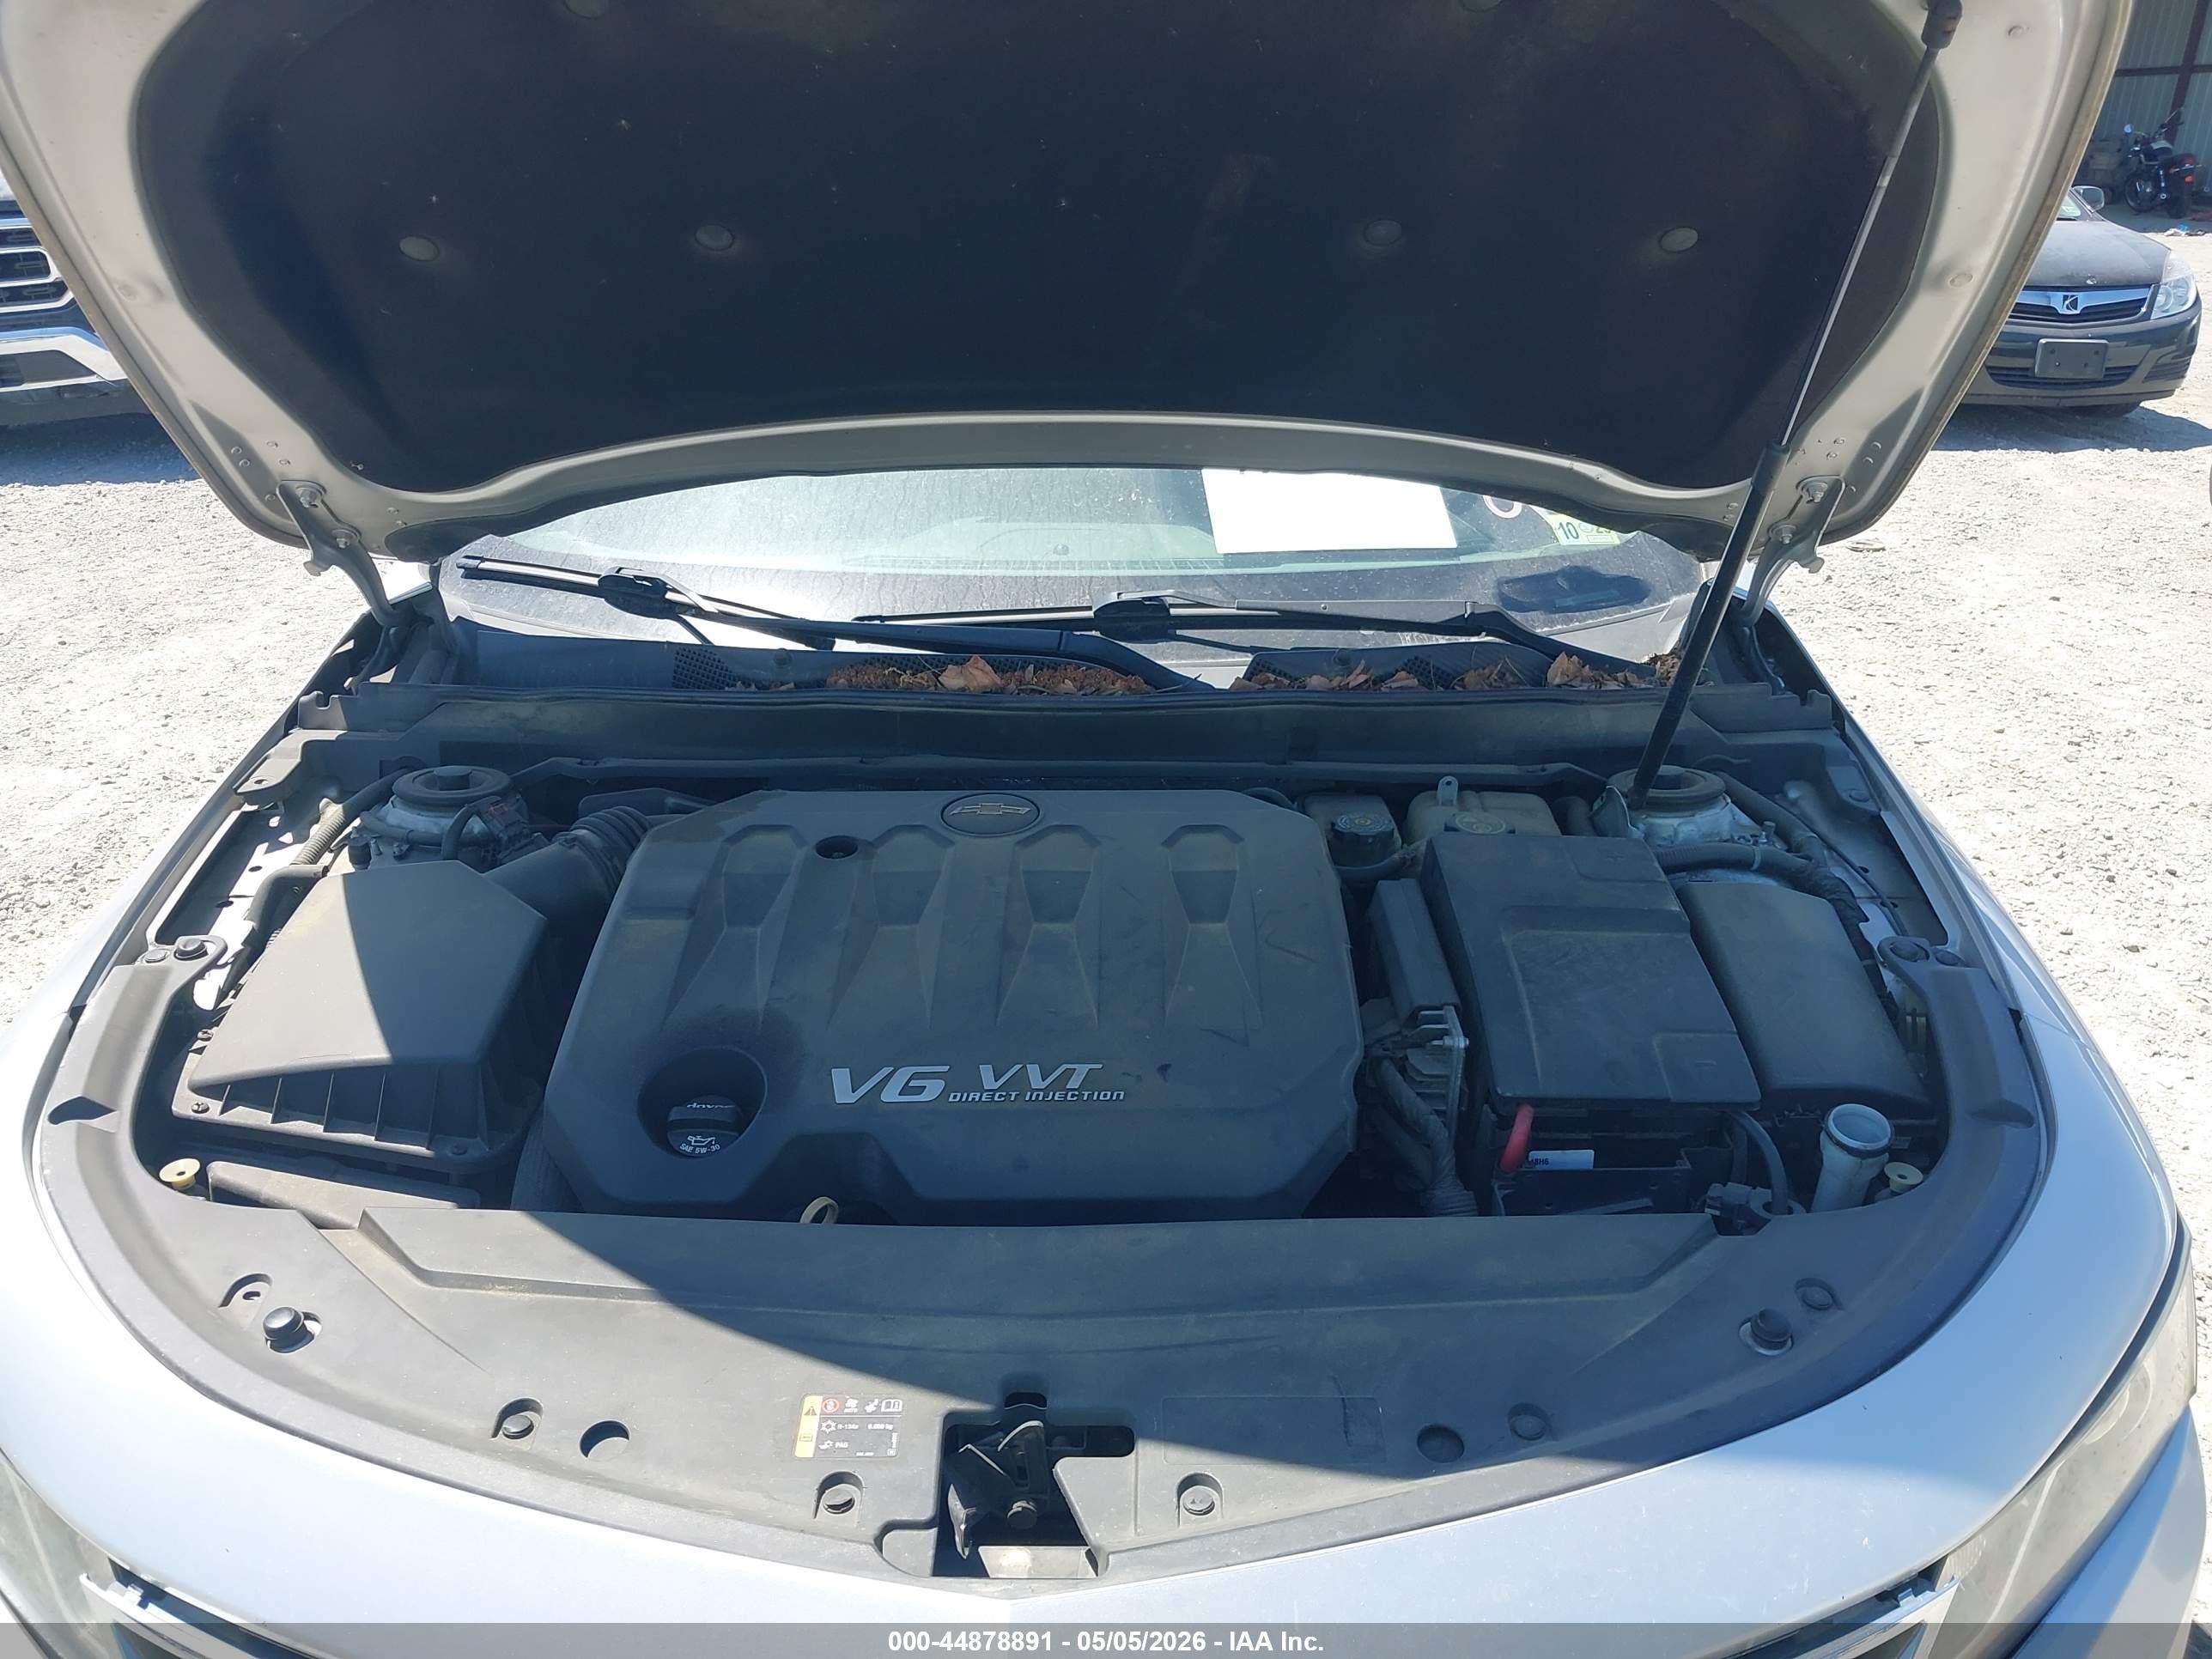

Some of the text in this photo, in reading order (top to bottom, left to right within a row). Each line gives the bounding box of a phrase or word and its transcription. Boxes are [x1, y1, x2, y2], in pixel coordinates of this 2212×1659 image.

[1558, 522, 1579, 539] 10
[831, 1064, 1103, 1103] V6 VVT
[948, 1091, 1126, 1102] DIRECT INJECTION
[679, 1143, 720, 1154] SAE 5W-30
